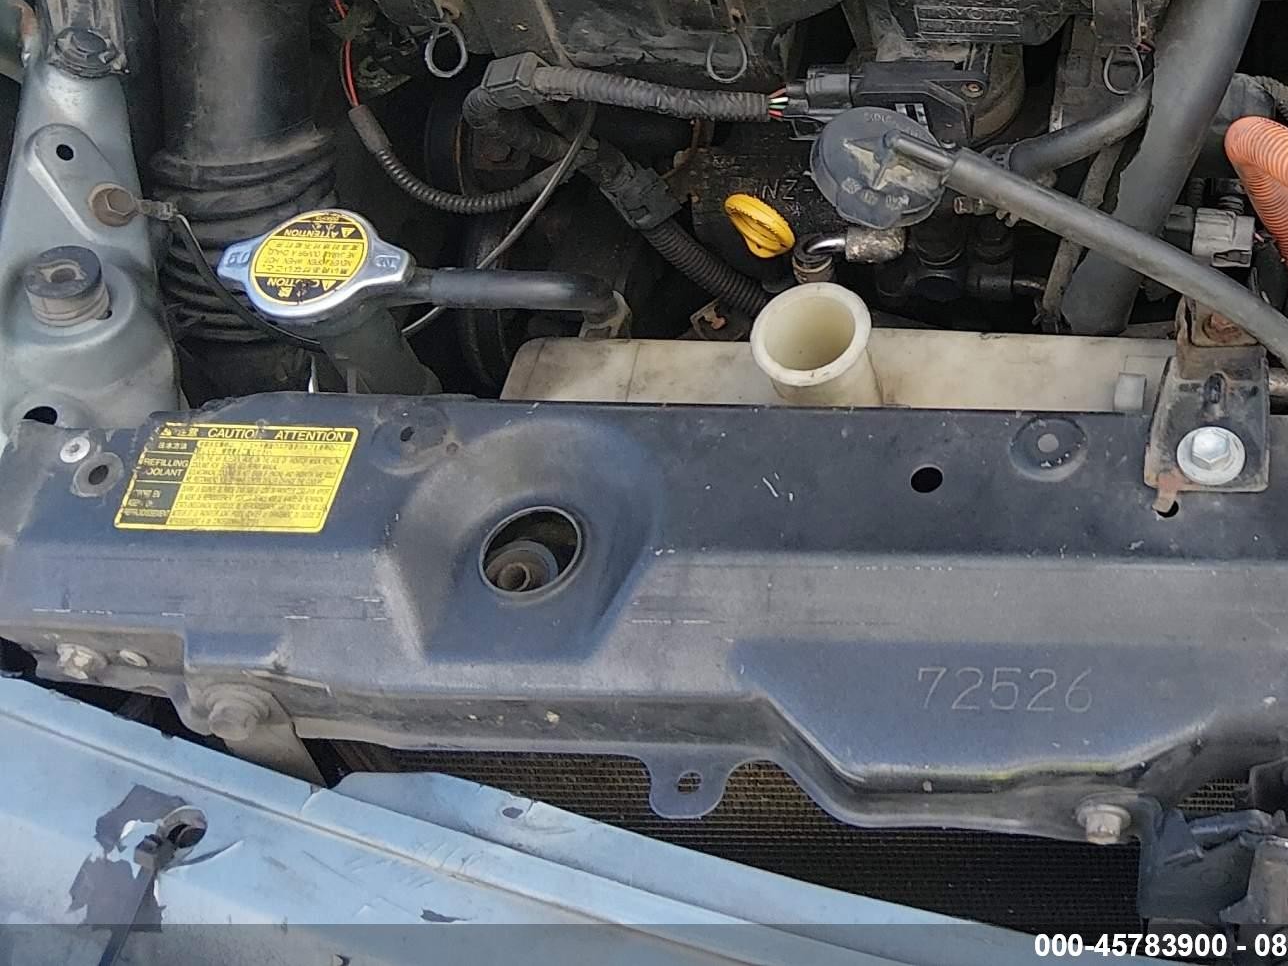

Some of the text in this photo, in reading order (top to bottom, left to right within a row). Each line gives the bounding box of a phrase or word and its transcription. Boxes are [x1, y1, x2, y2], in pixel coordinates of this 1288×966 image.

[283, 229, 340, 238] ATTENTION
[266, 278, 321, 288] CUTION
[208, 427, 261, 439] CAUTIO
[274, 430, 347, 442] ATTENTION
[143, 467, 184, 477] OOLANT
[917, 666, 1093, 713] 72526
